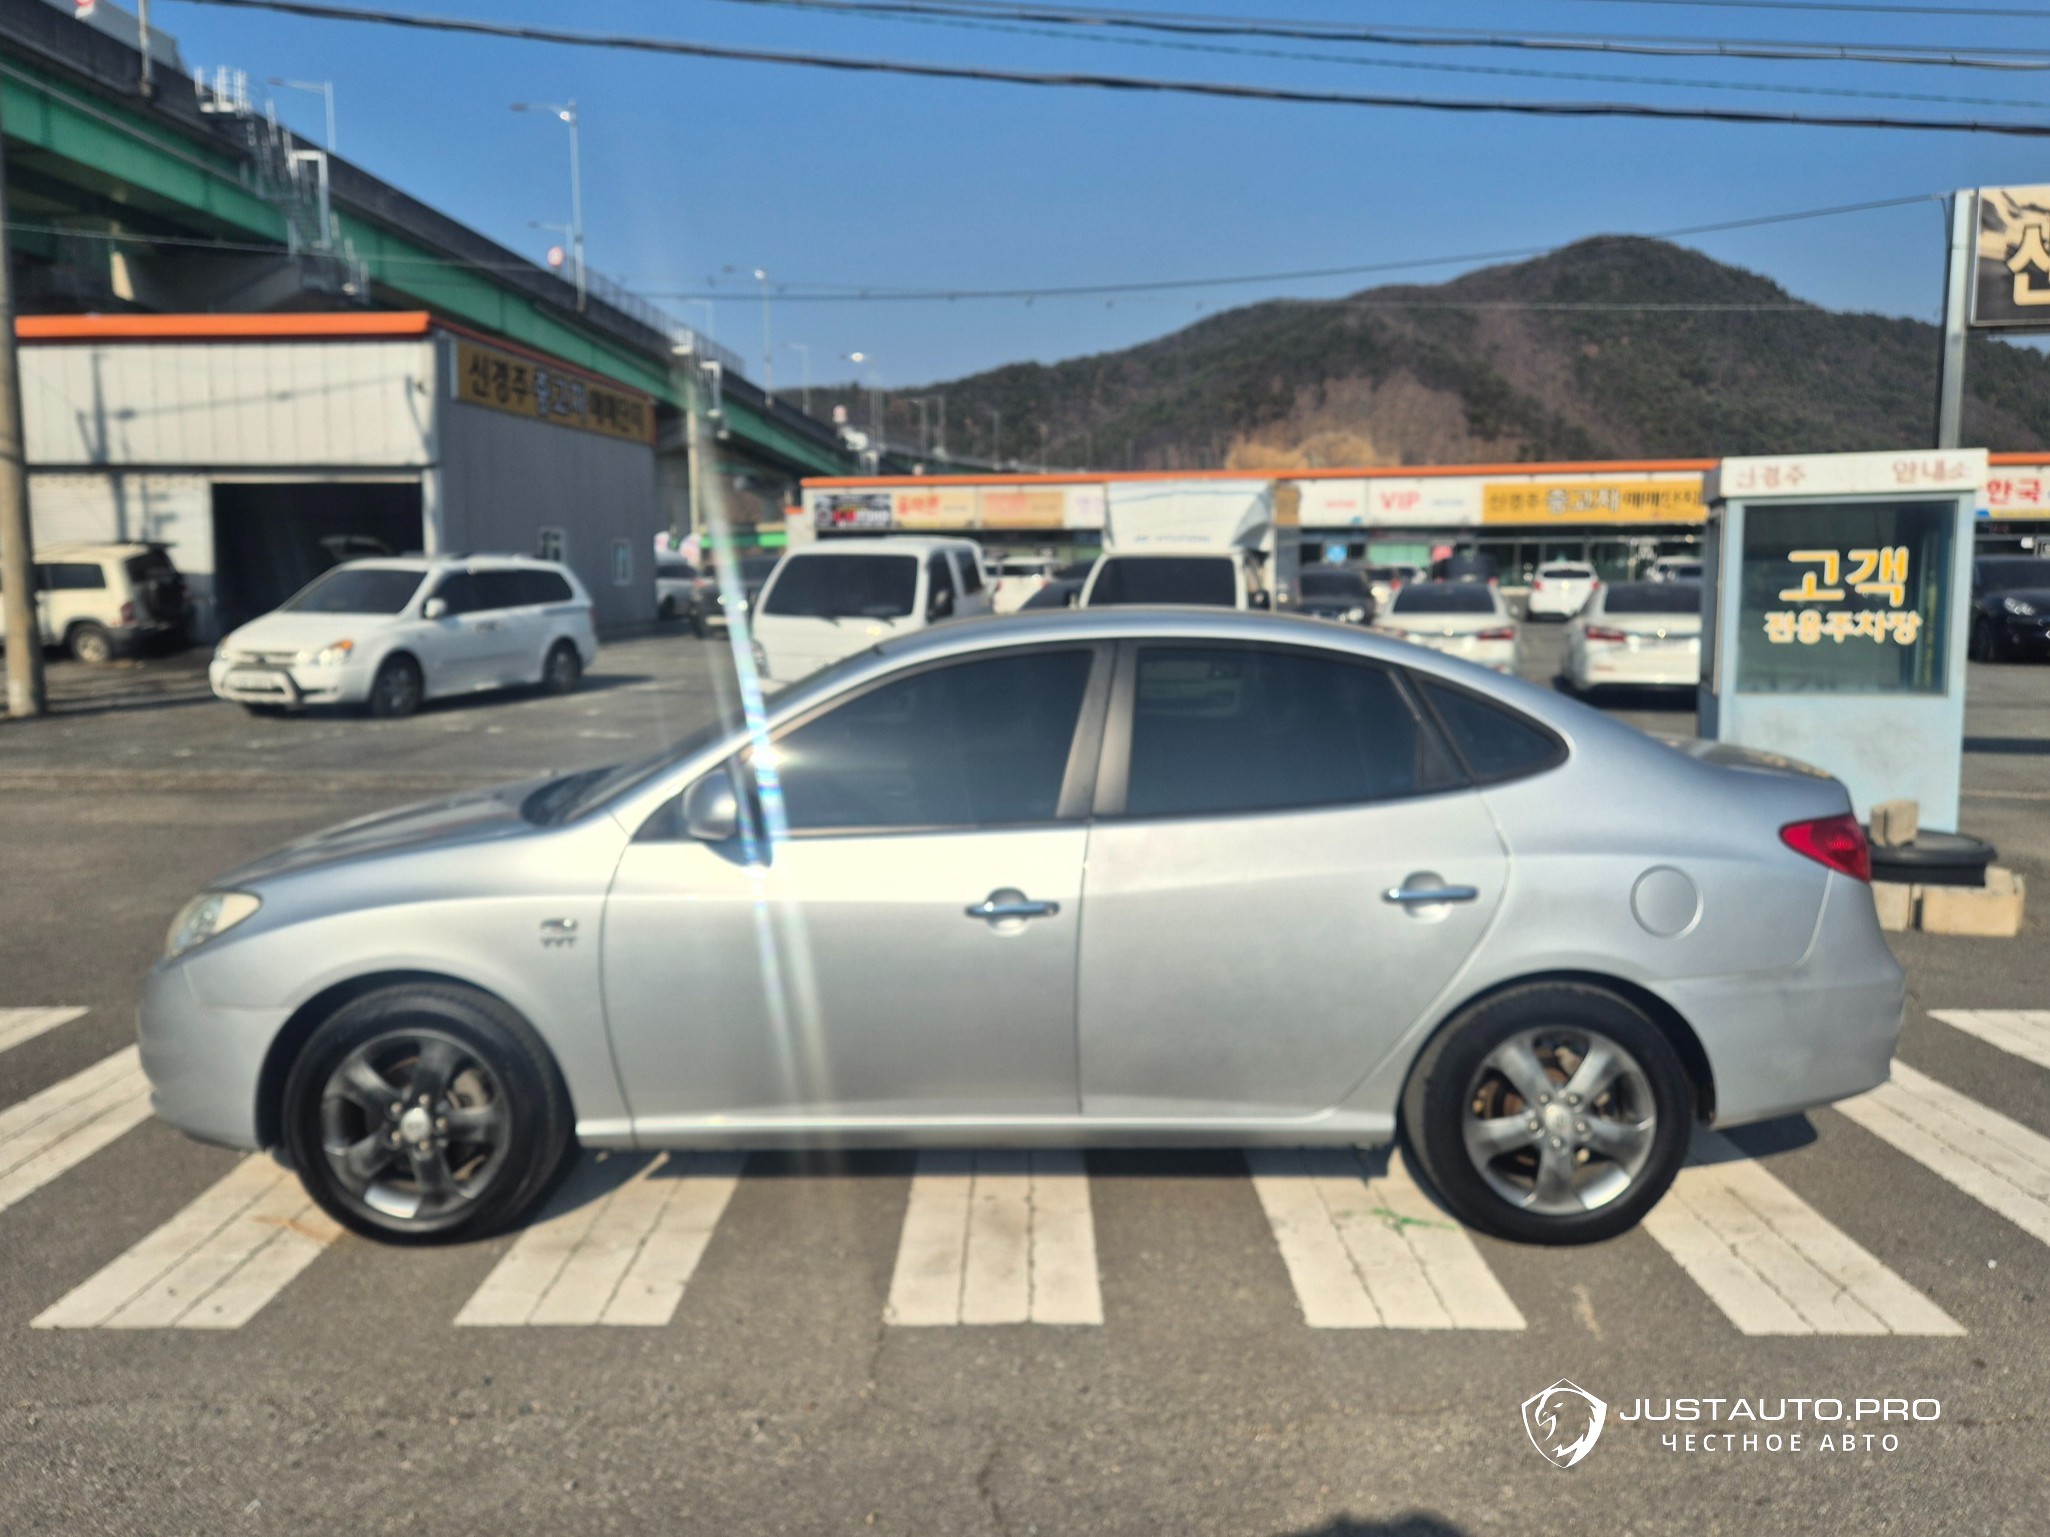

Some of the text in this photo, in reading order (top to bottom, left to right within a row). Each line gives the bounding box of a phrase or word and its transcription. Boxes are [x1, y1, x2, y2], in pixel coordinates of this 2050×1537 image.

[1379, 490, 1421, 511] VIP
[1778, 545, 1910, 608] 고객
[1763, 608, 1924, 646] 전용주차장
